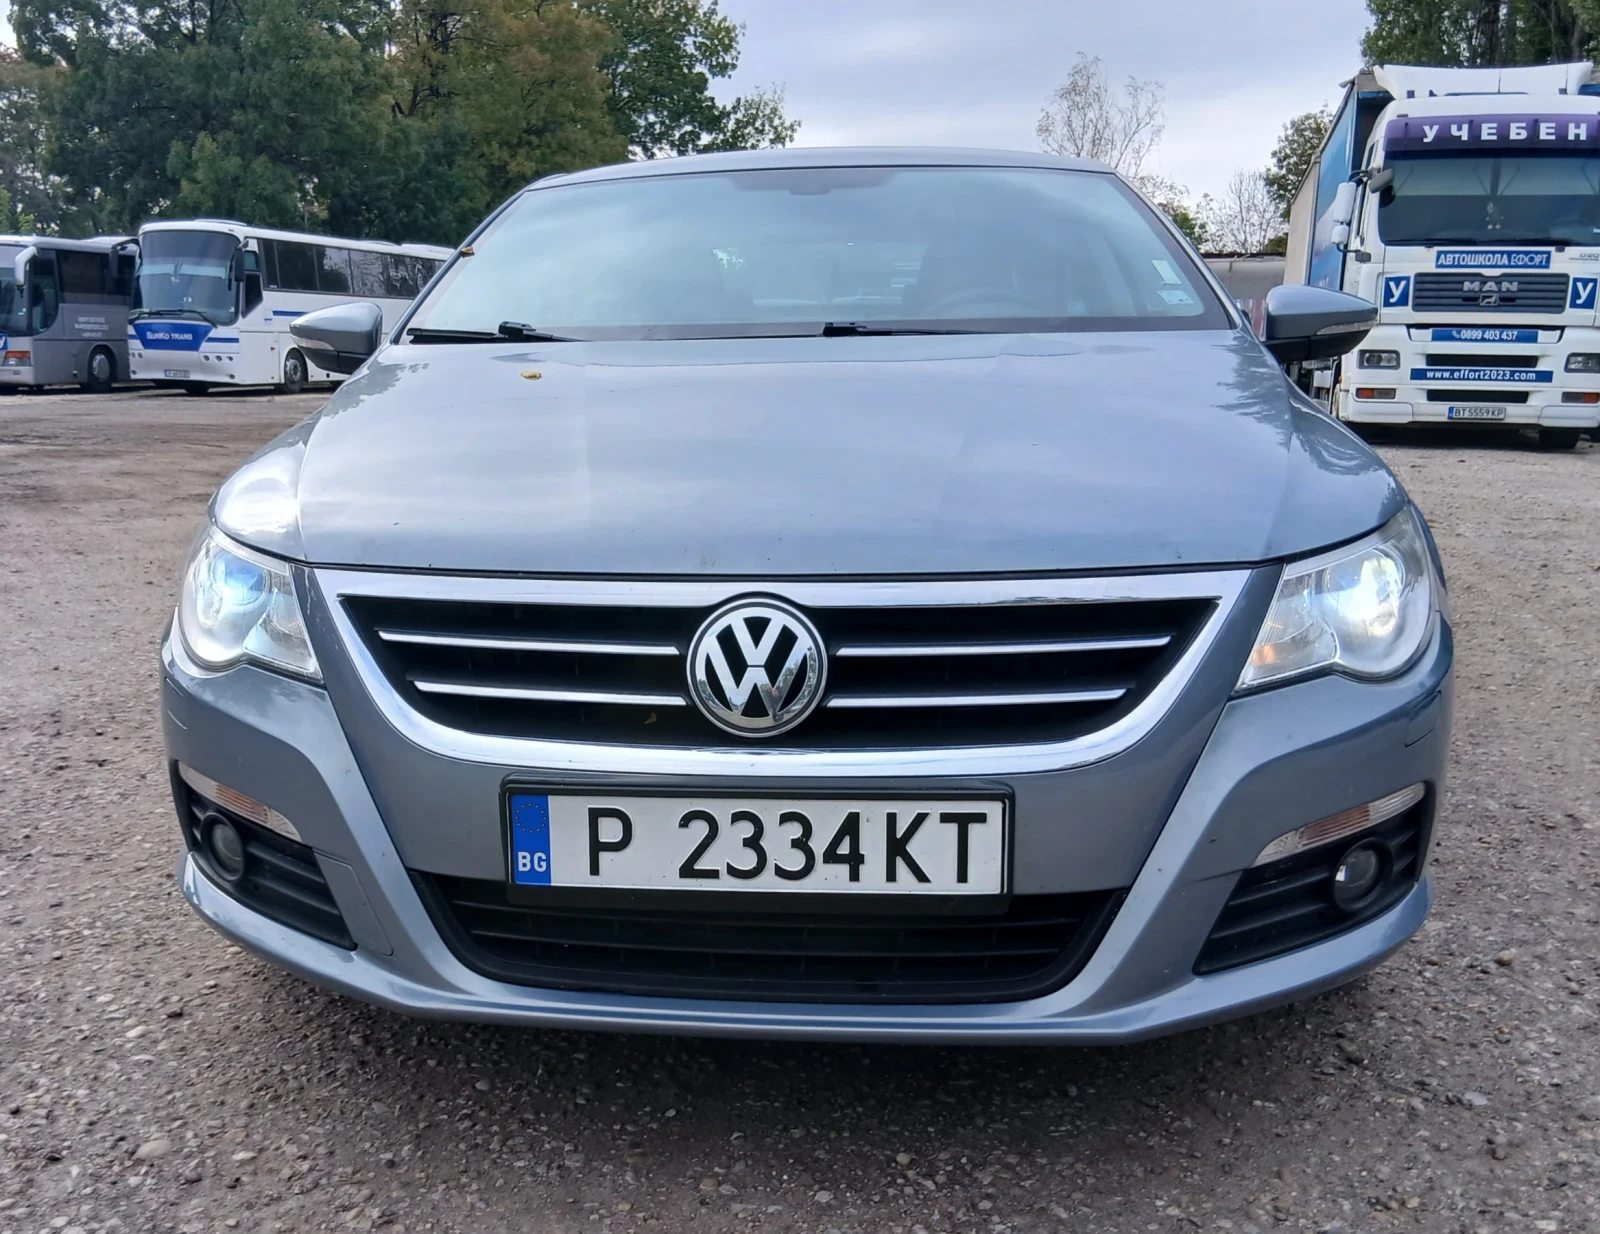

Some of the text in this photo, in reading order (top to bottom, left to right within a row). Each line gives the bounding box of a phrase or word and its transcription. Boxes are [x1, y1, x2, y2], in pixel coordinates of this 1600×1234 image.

[1423, 122, 1587, 142] УЧЕБЕН
[1437, 253, 1548, 266] АВТОШКОЛА ЕФОРТ
[1388, 280, 1406, 303] У
[1463, 281, 1518, 292] MAN
[1575, 281, 1594, 304] У
[1460, 330, 1518, 341] 0899 403 437
[1426, 369, 1536, 381] www.effort2023.com
[587, 807, 988, 884] P 2334 KT
[517, 851, 547, 873] BG
